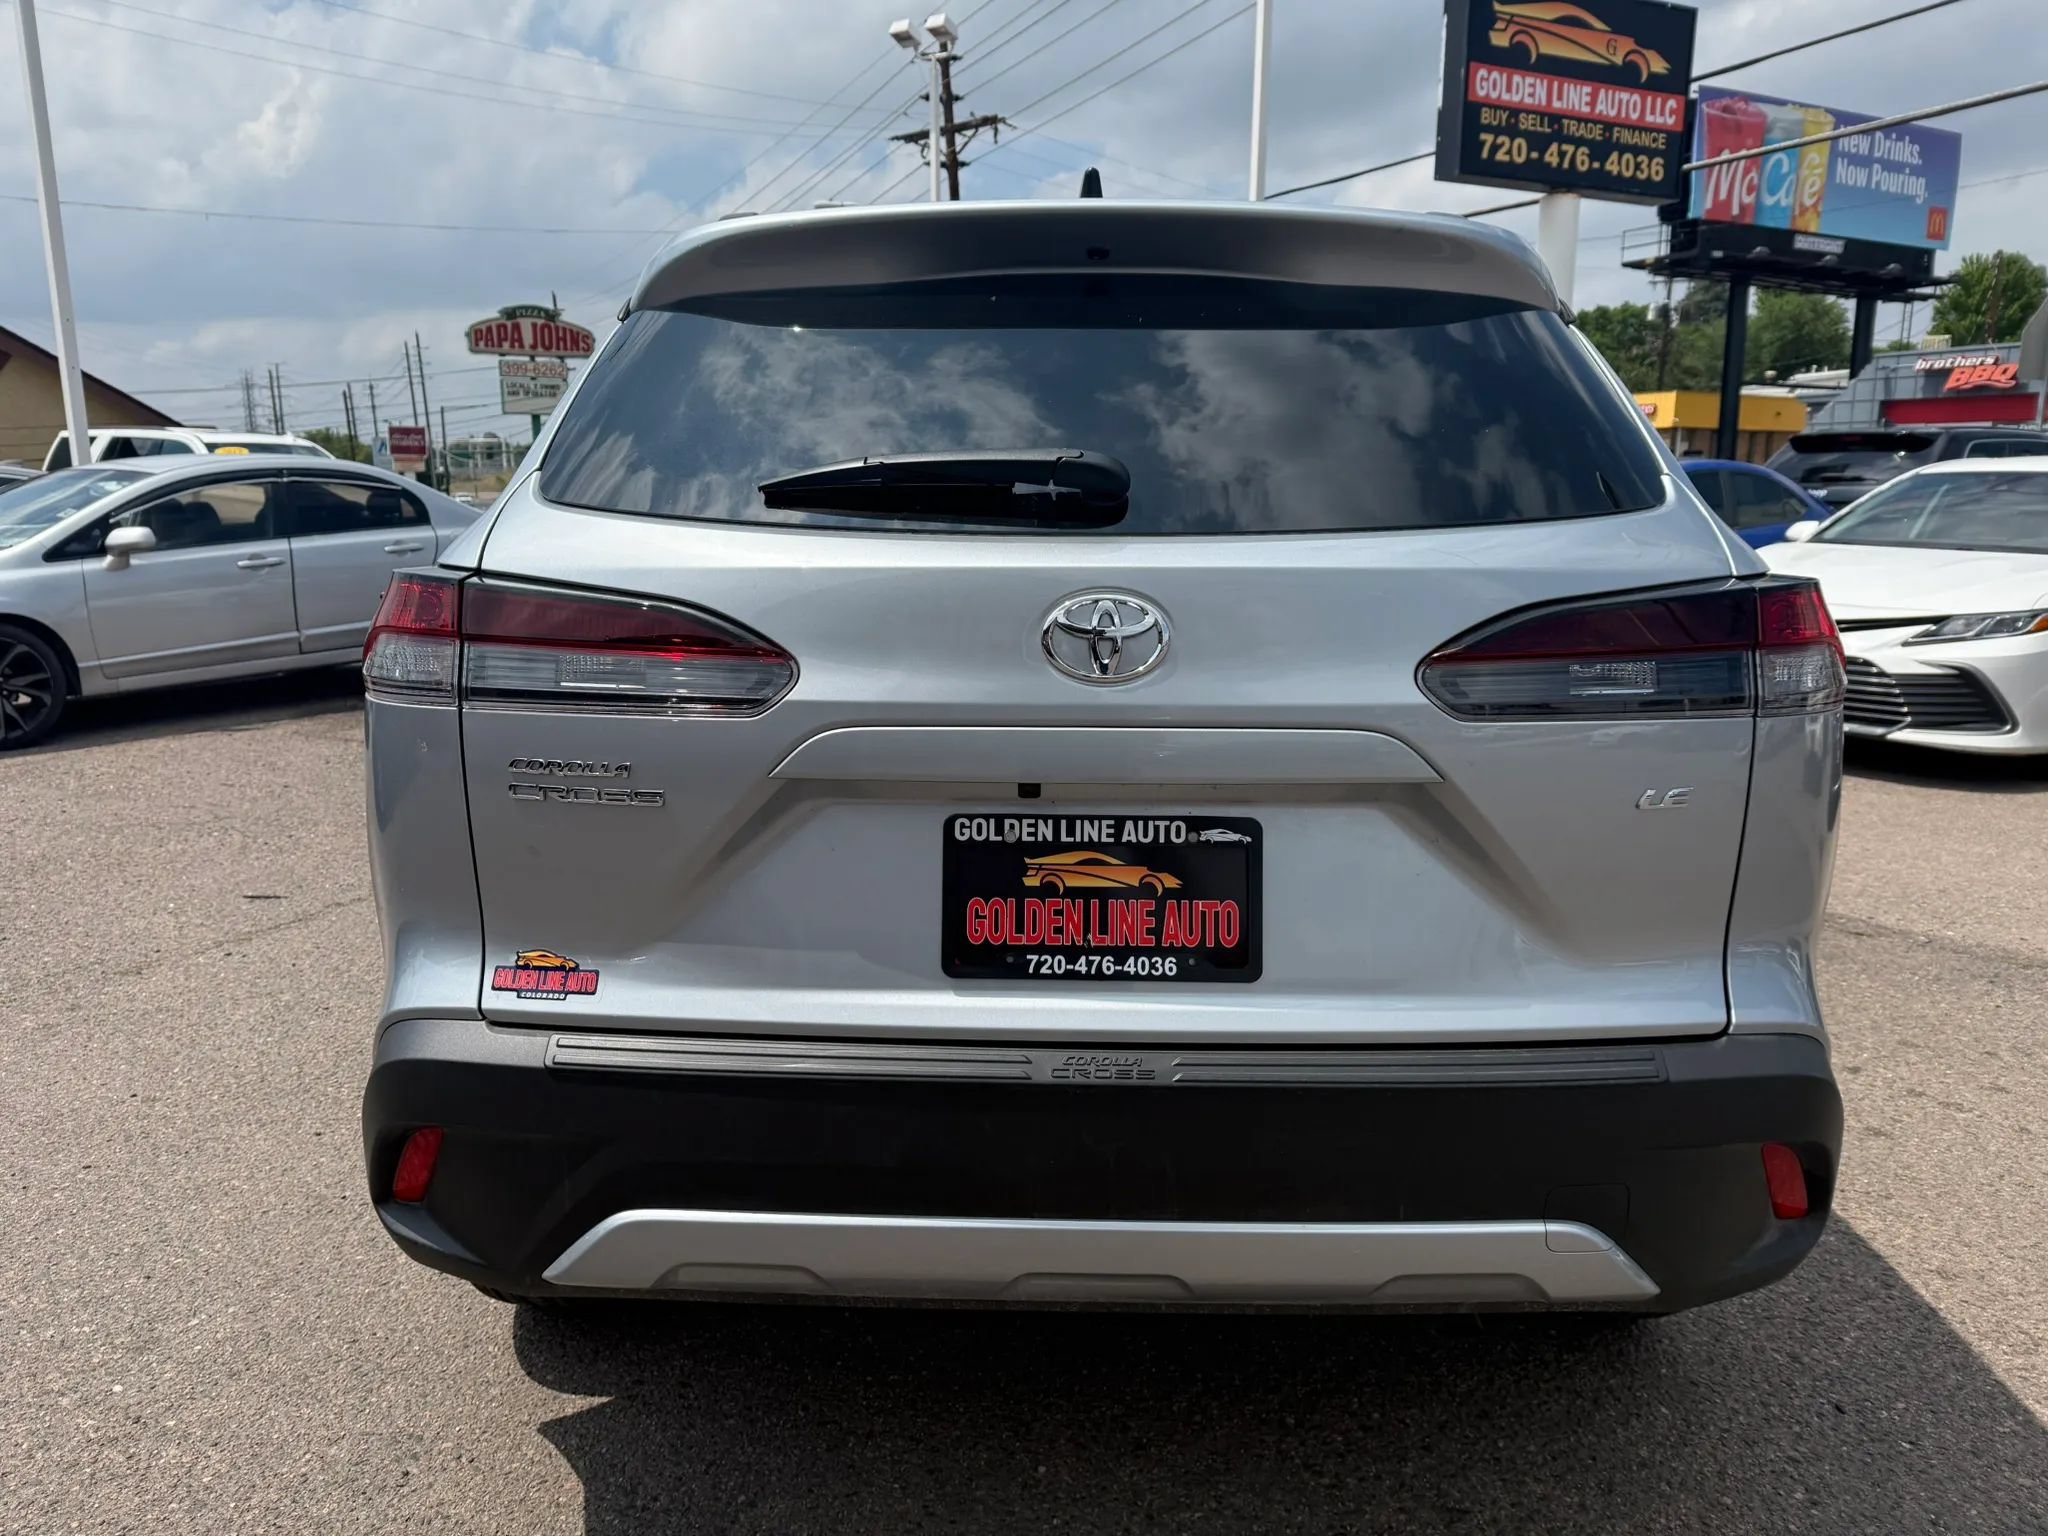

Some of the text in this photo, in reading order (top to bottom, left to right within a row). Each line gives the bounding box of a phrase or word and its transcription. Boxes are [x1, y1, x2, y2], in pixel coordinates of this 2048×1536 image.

[1475, 68, 1677, 126] GOLDEN LINE AUTO LLC
[1480, 107, 1667, 149] BUY SELL TRADE FINANCE
[1874, 130, 1923, 165] Drinks.
[1836, 157, 1929, 204] Now Pouring.
[473, 320, 591, 352] PAPA JOHNS
[504, 361, 565, 377] 399-6262
[1914, 355, 1998, 371] brothers
[1943, 363, 2019, 392] BBQ
[508, 757, 632, 779] COROLLA
[508, 782, 665, 807] CROSS
[1635, 787, 1694, 810] LE
[954, 817, 1188, 844] GOLDEN LINE AUTO
[966, 897, 1240, 948] GOLDEN LINE AUTO
[1026, 954, 1178, 976] 720-476-4036
[493, 968, 597, 992] GOLDEN LINE AUTO
[520, 991, 566, 999] COLORADO
[1061, 1056, 1143, 1067] COROLLA
[1051, 1068, 1156, 1080] CROSS
